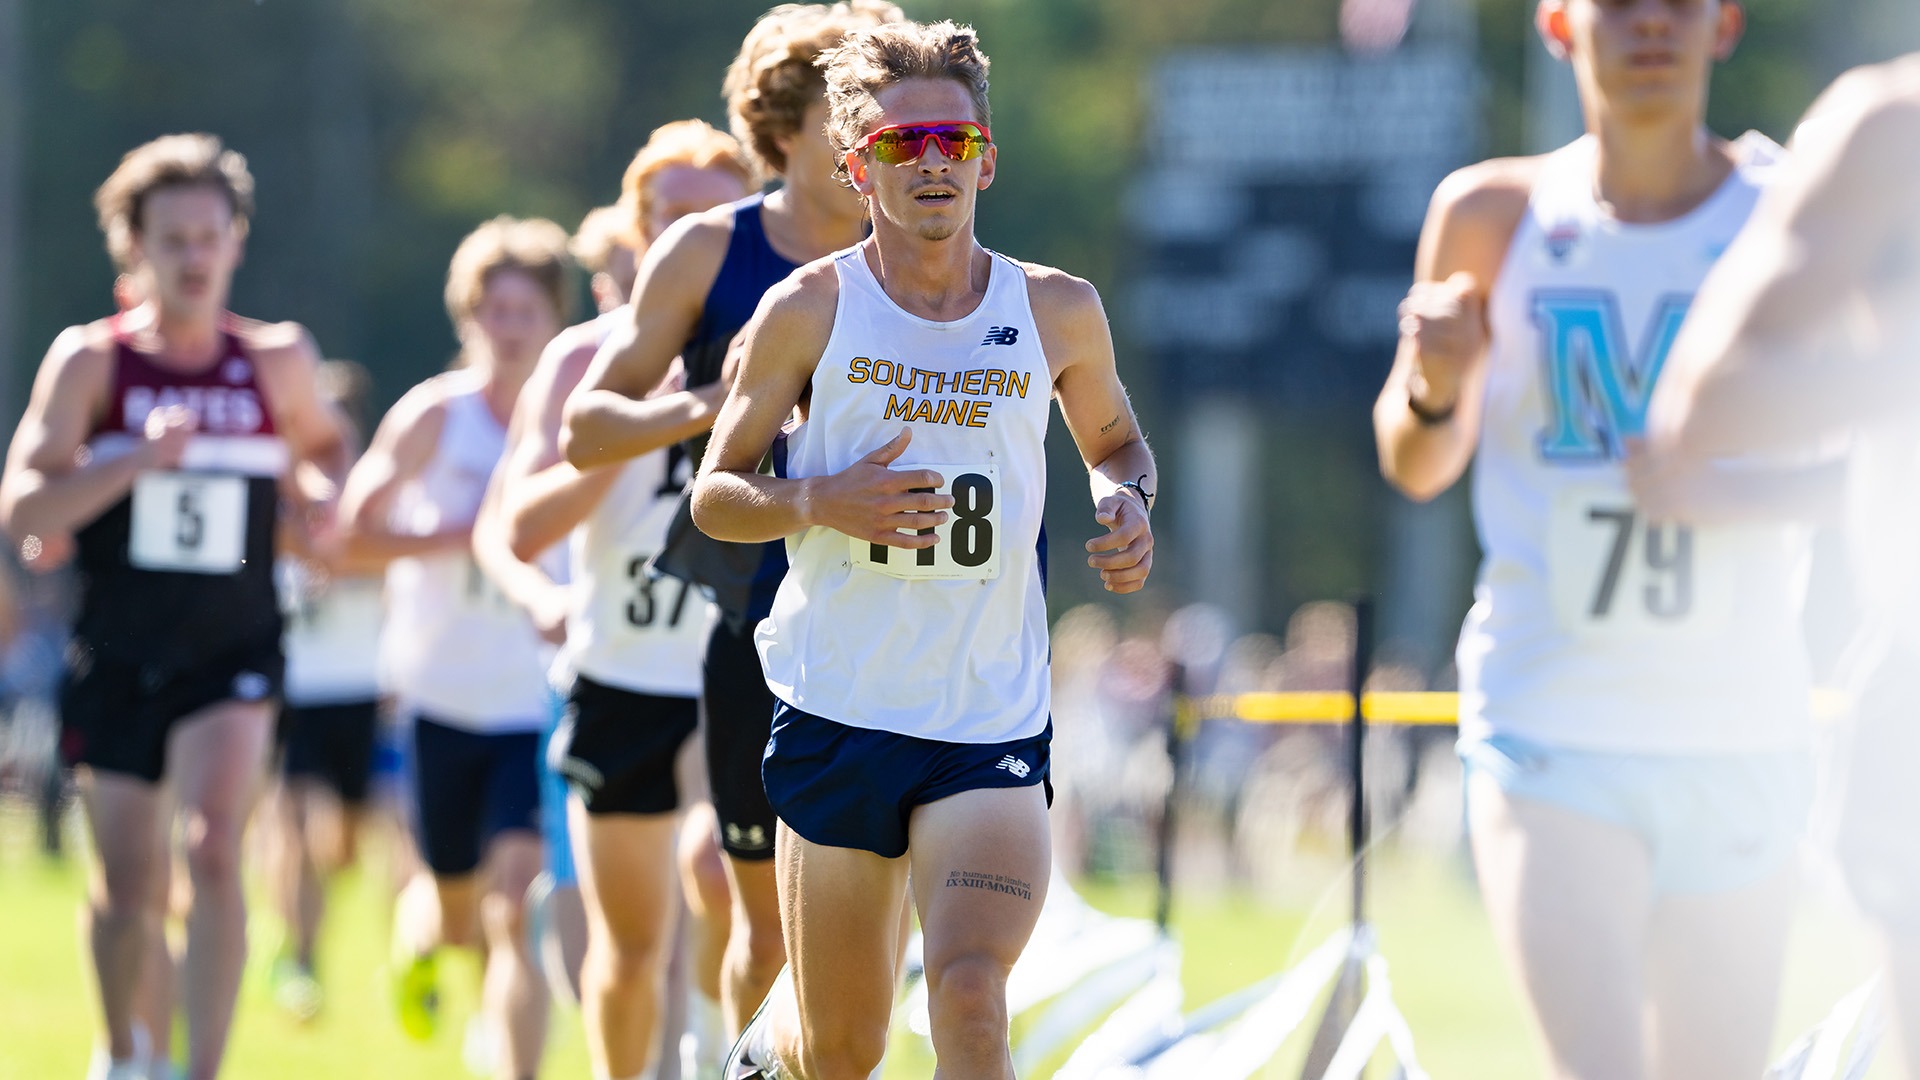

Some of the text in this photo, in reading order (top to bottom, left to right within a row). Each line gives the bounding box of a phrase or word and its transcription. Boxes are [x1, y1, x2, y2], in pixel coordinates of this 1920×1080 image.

[847, 356, 1031, 399] SOUTHERN
[1529, 288, 1701, 463] M
[883, 394, 992, 428] MAINE
[174, 490, 204, 549] 5
[1584, 507, 1695, 621] 79
[962, 871, 993, 880] human
